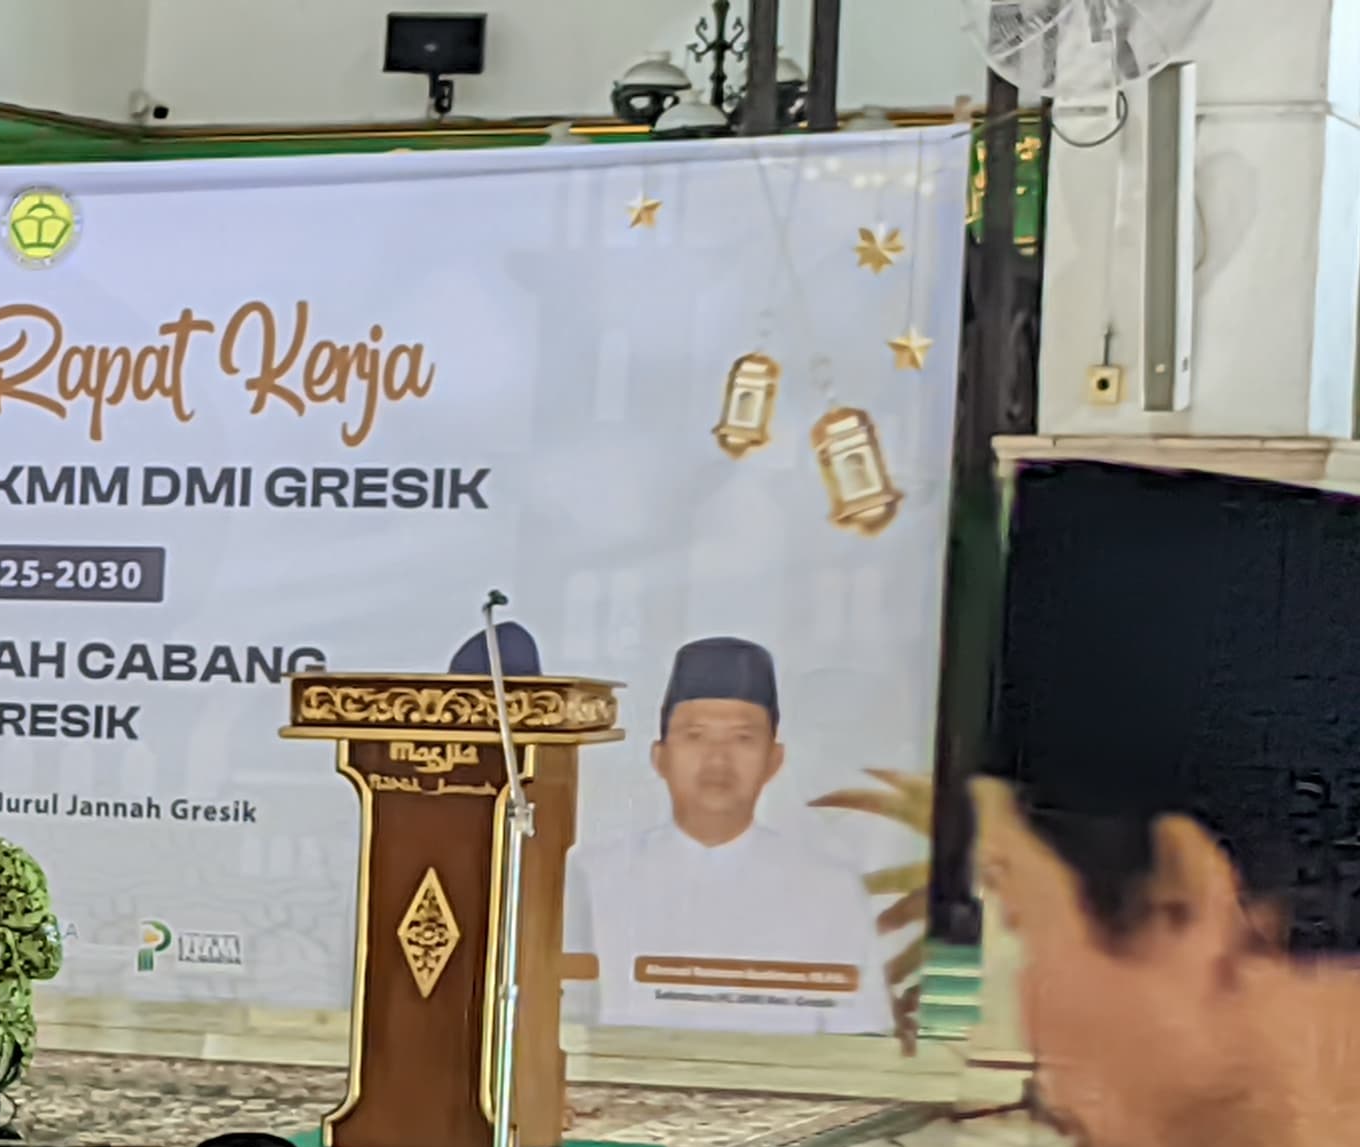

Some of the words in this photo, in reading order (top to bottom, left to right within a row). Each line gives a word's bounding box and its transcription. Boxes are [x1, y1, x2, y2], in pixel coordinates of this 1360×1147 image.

[219, 300, 435, 448] Kerja
[141, 466, 253, 508] DMI
[264, 466, 491, 510] GRESIK
[77, 642, 327, 684] CABANG
[65, 794, 161, 820] Jannah
[170, 798, 257, 823] Gresik
